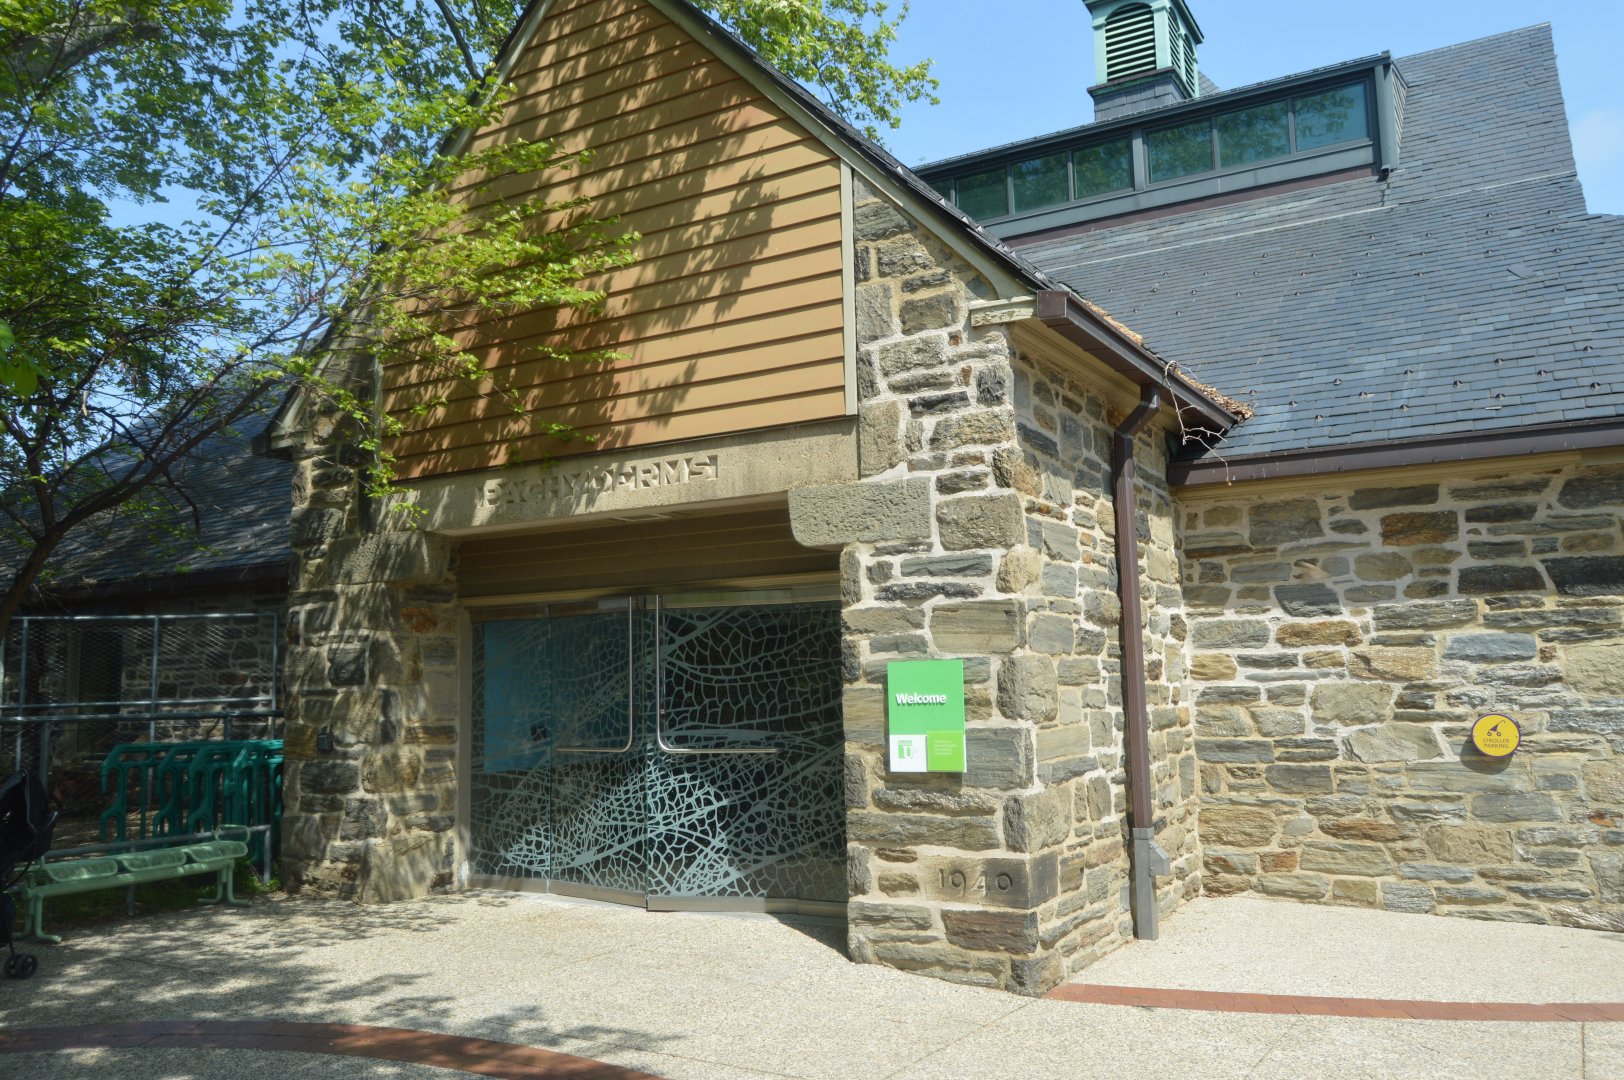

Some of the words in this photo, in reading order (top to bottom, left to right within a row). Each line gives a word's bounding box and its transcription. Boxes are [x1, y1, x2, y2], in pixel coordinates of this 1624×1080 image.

[482, 455, 716, 506] PACHYDERMS
[896, 693, 947, 705] Welcome
[938, 868, 1014, 897] 1940
